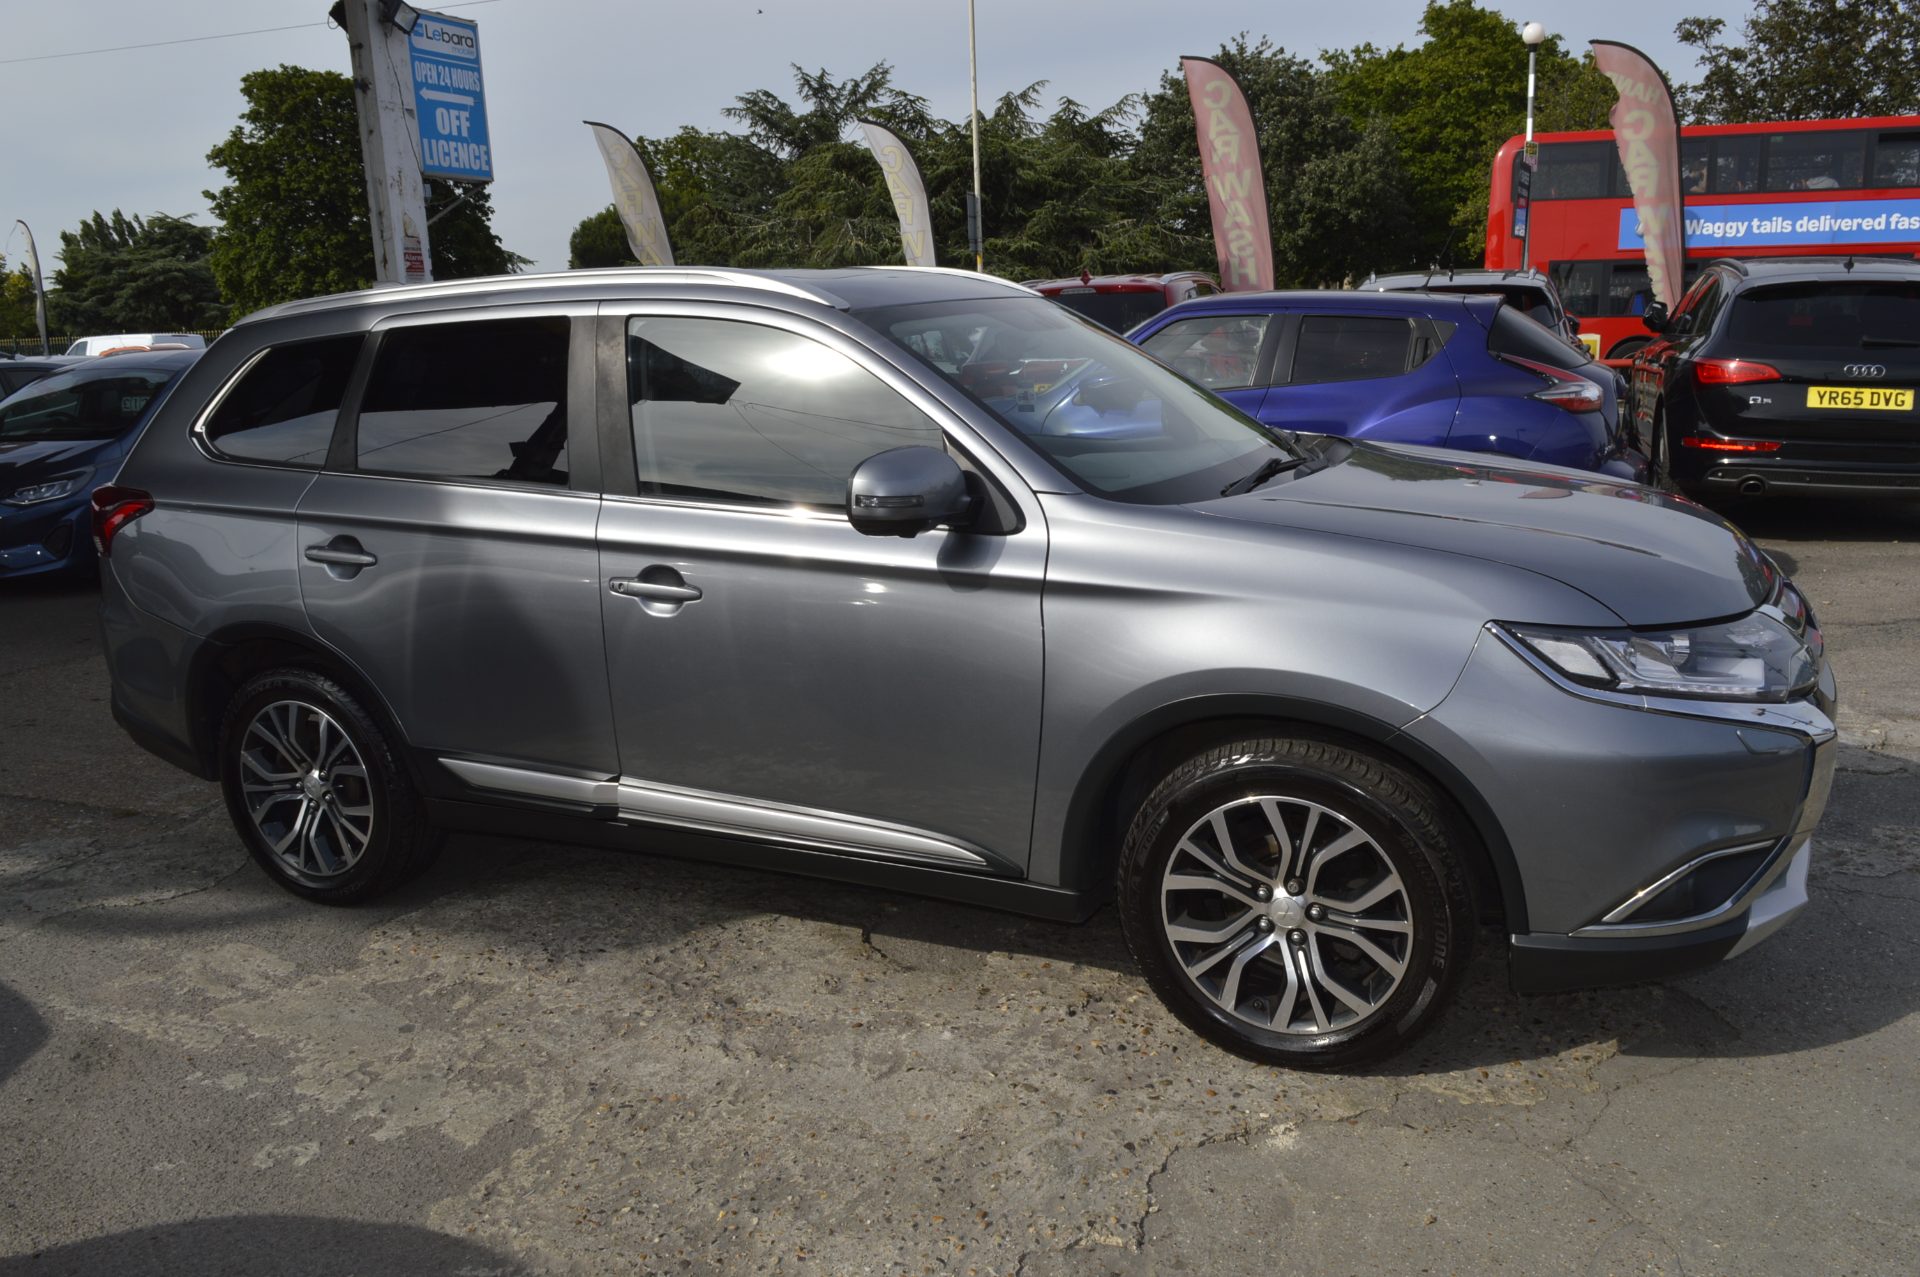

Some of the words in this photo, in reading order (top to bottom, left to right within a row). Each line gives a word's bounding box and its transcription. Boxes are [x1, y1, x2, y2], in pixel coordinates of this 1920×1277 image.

[424, 23, 474, 48] Lebara
[414, 61, 438, 85] OPEN
[439, 65, 451, 87] 24
[451, 69, 480, 92] HOURS
[435, 107, 470, 137] OFF
[422, 138, 489, 171] LICENCE
[1685, 219, 1748, 237] Waggy
[1751, 216, 1792, 233] tails
[1795, 214, 1886, 232] delivered
[1817, 390, 1864, 406] YR65
[1869, 391, 1905, 407] DVG
